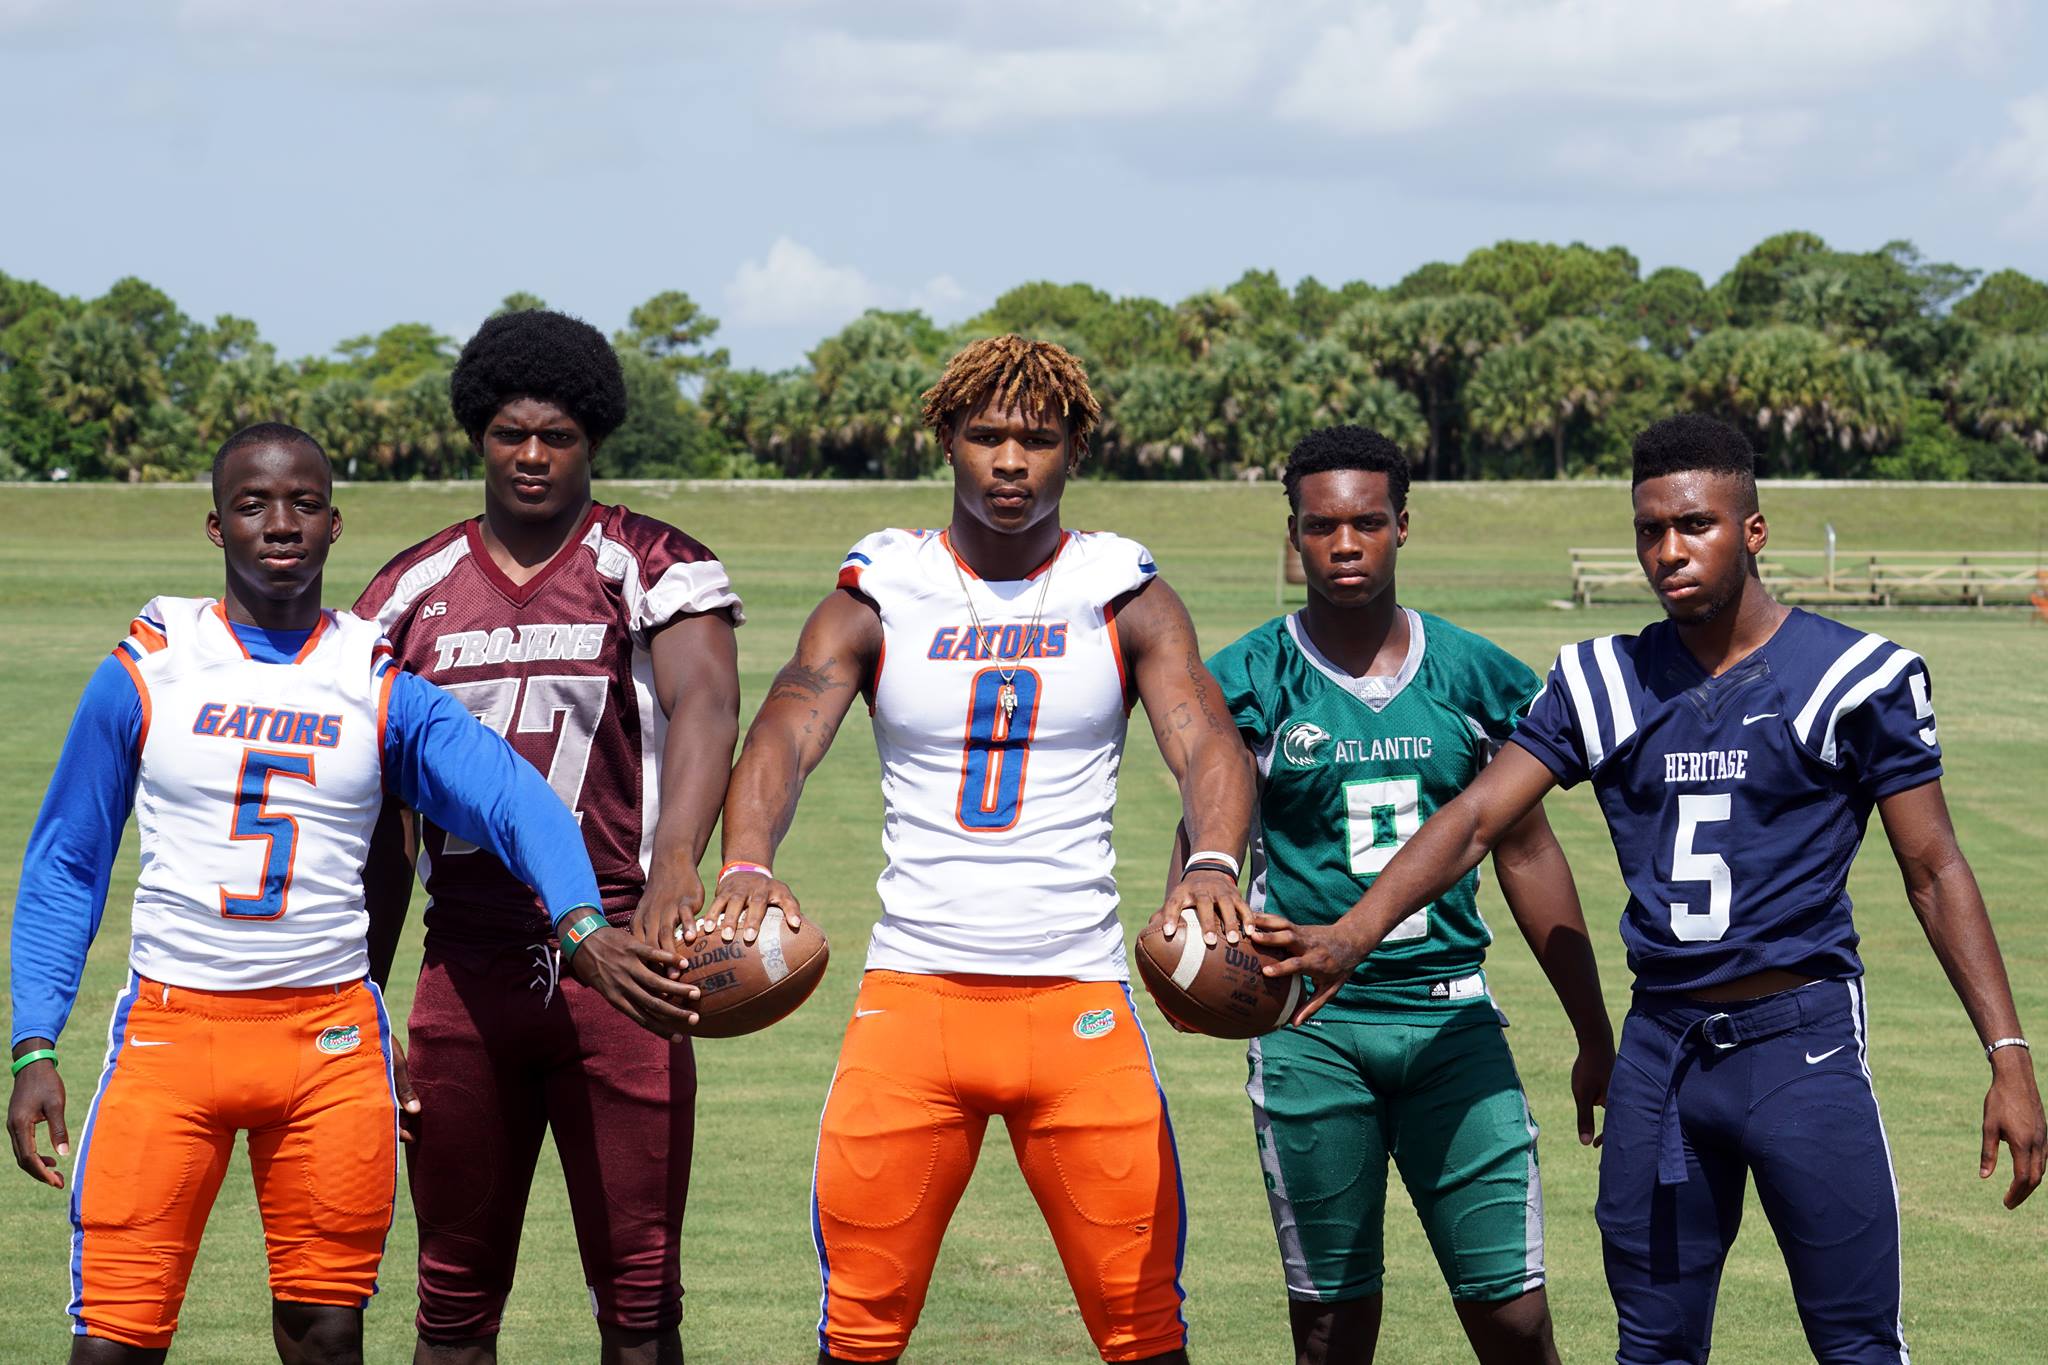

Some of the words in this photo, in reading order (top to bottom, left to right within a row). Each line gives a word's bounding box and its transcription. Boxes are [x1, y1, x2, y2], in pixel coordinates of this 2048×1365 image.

[433, 622, 608, 672] TROJANS
[927, 621, 1069, 661] GATORS
[192, 702, 344, 750] GATORS
[1908, 671, 1937, 746] 5
[1335, 736, 1433, 763] ATLANTIC
[1663, 750, 1748, 782] HERITAGE
[219, 747, 317, 922] 5
[1670, 793, 1732, 942] 5
[683, 940, 743, 972] ALDING
